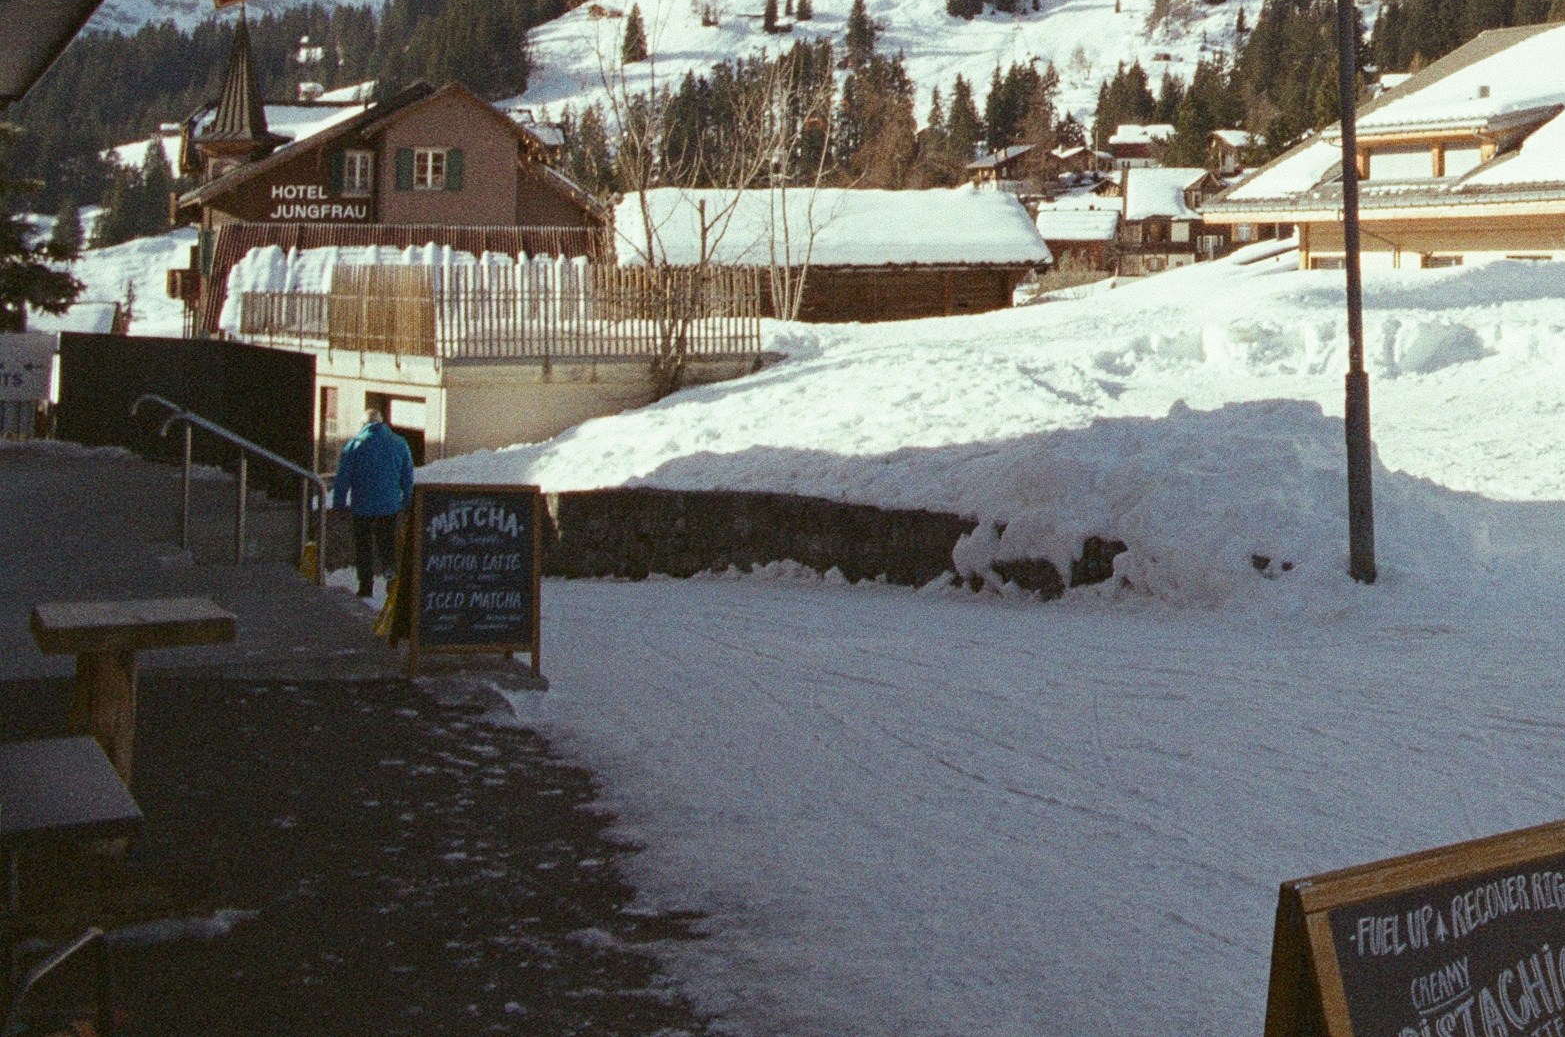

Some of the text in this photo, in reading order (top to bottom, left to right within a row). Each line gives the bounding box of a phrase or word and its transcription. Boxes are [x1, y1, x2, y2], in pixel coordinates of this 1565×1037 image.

[271, 184, 328, 199] HOTEL
[270, 203, 367, 219] JUNGFRAU
[430, 505, 518, 540] MATCHA
[425, 553, 521, 572] MATCHA LATTE
[425, 591, 522, 611] ICED MATCHA
[1357, 915, 1407, 957] FUEL
[1406, 904, 1434, 950] UP
[1450, 874, 1531, 939] RECOVER
[1410, 956, 1471, 1010] CREAMY
